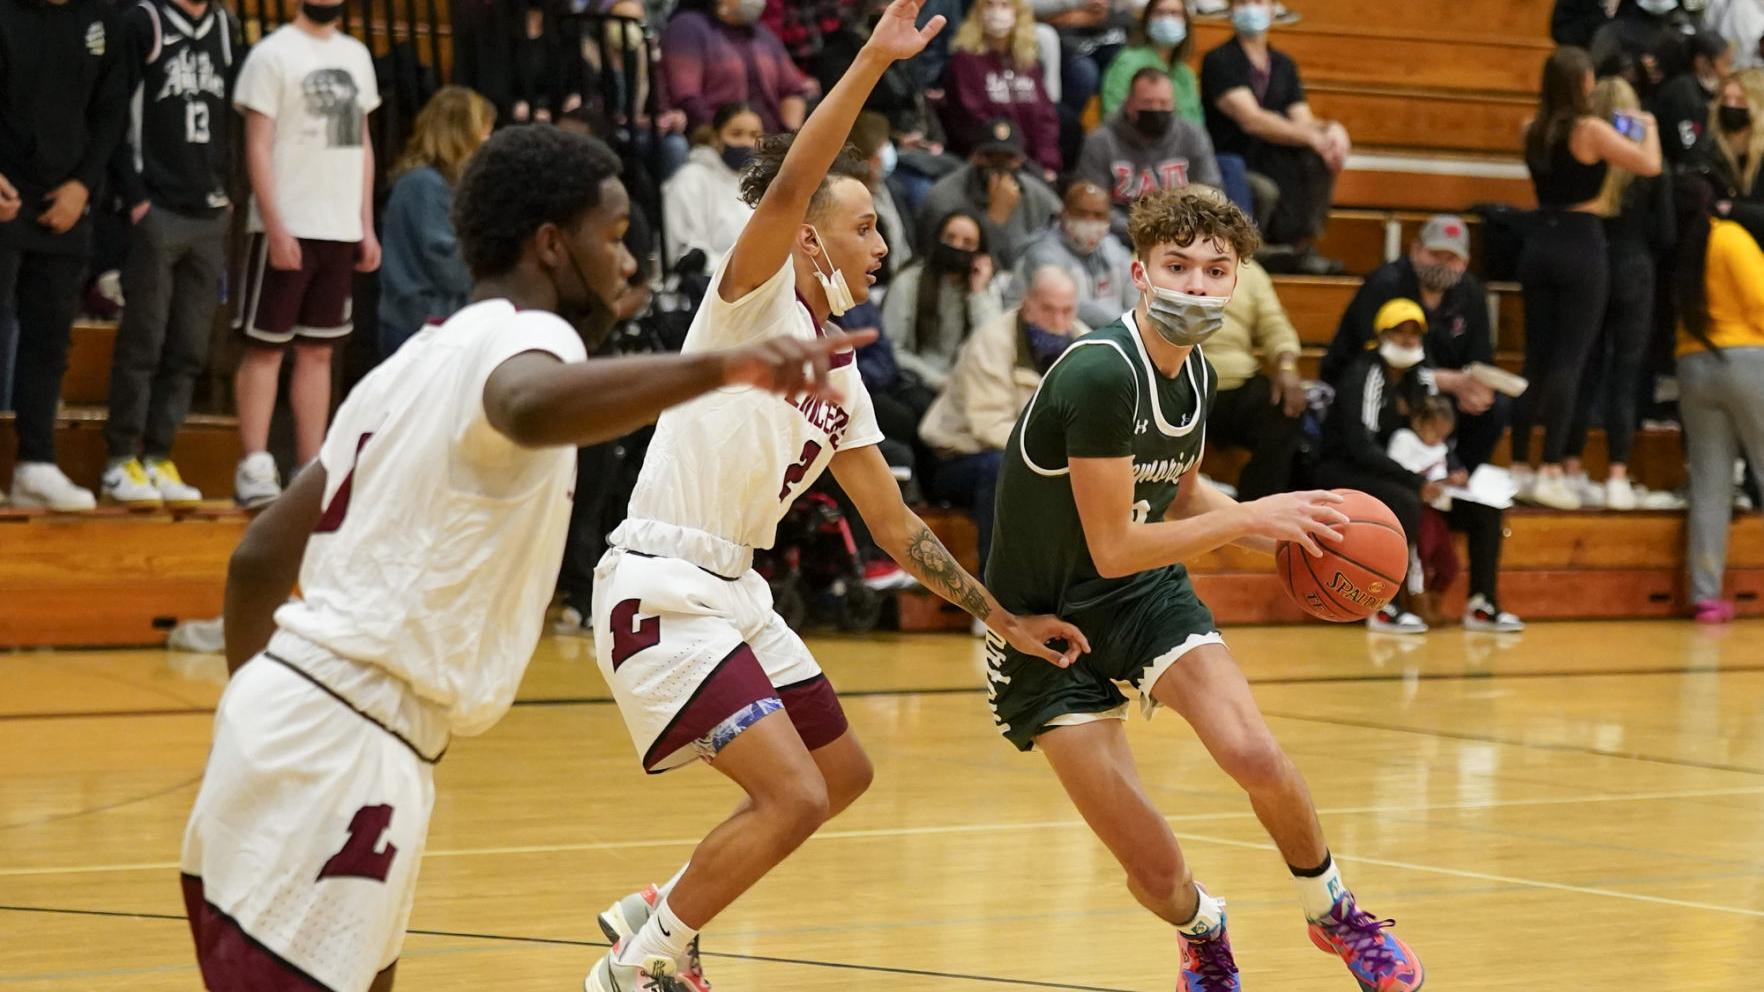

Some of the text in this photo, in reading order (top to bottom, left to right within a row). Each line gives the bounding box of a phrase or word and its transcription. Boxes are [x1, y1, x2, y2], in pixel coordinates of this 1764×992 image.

[185, 101, 211, 144] 13
[779, 439, 822, 503] 2
[609, 598, 661, 674] L
[314, 803, 398, 884] L
